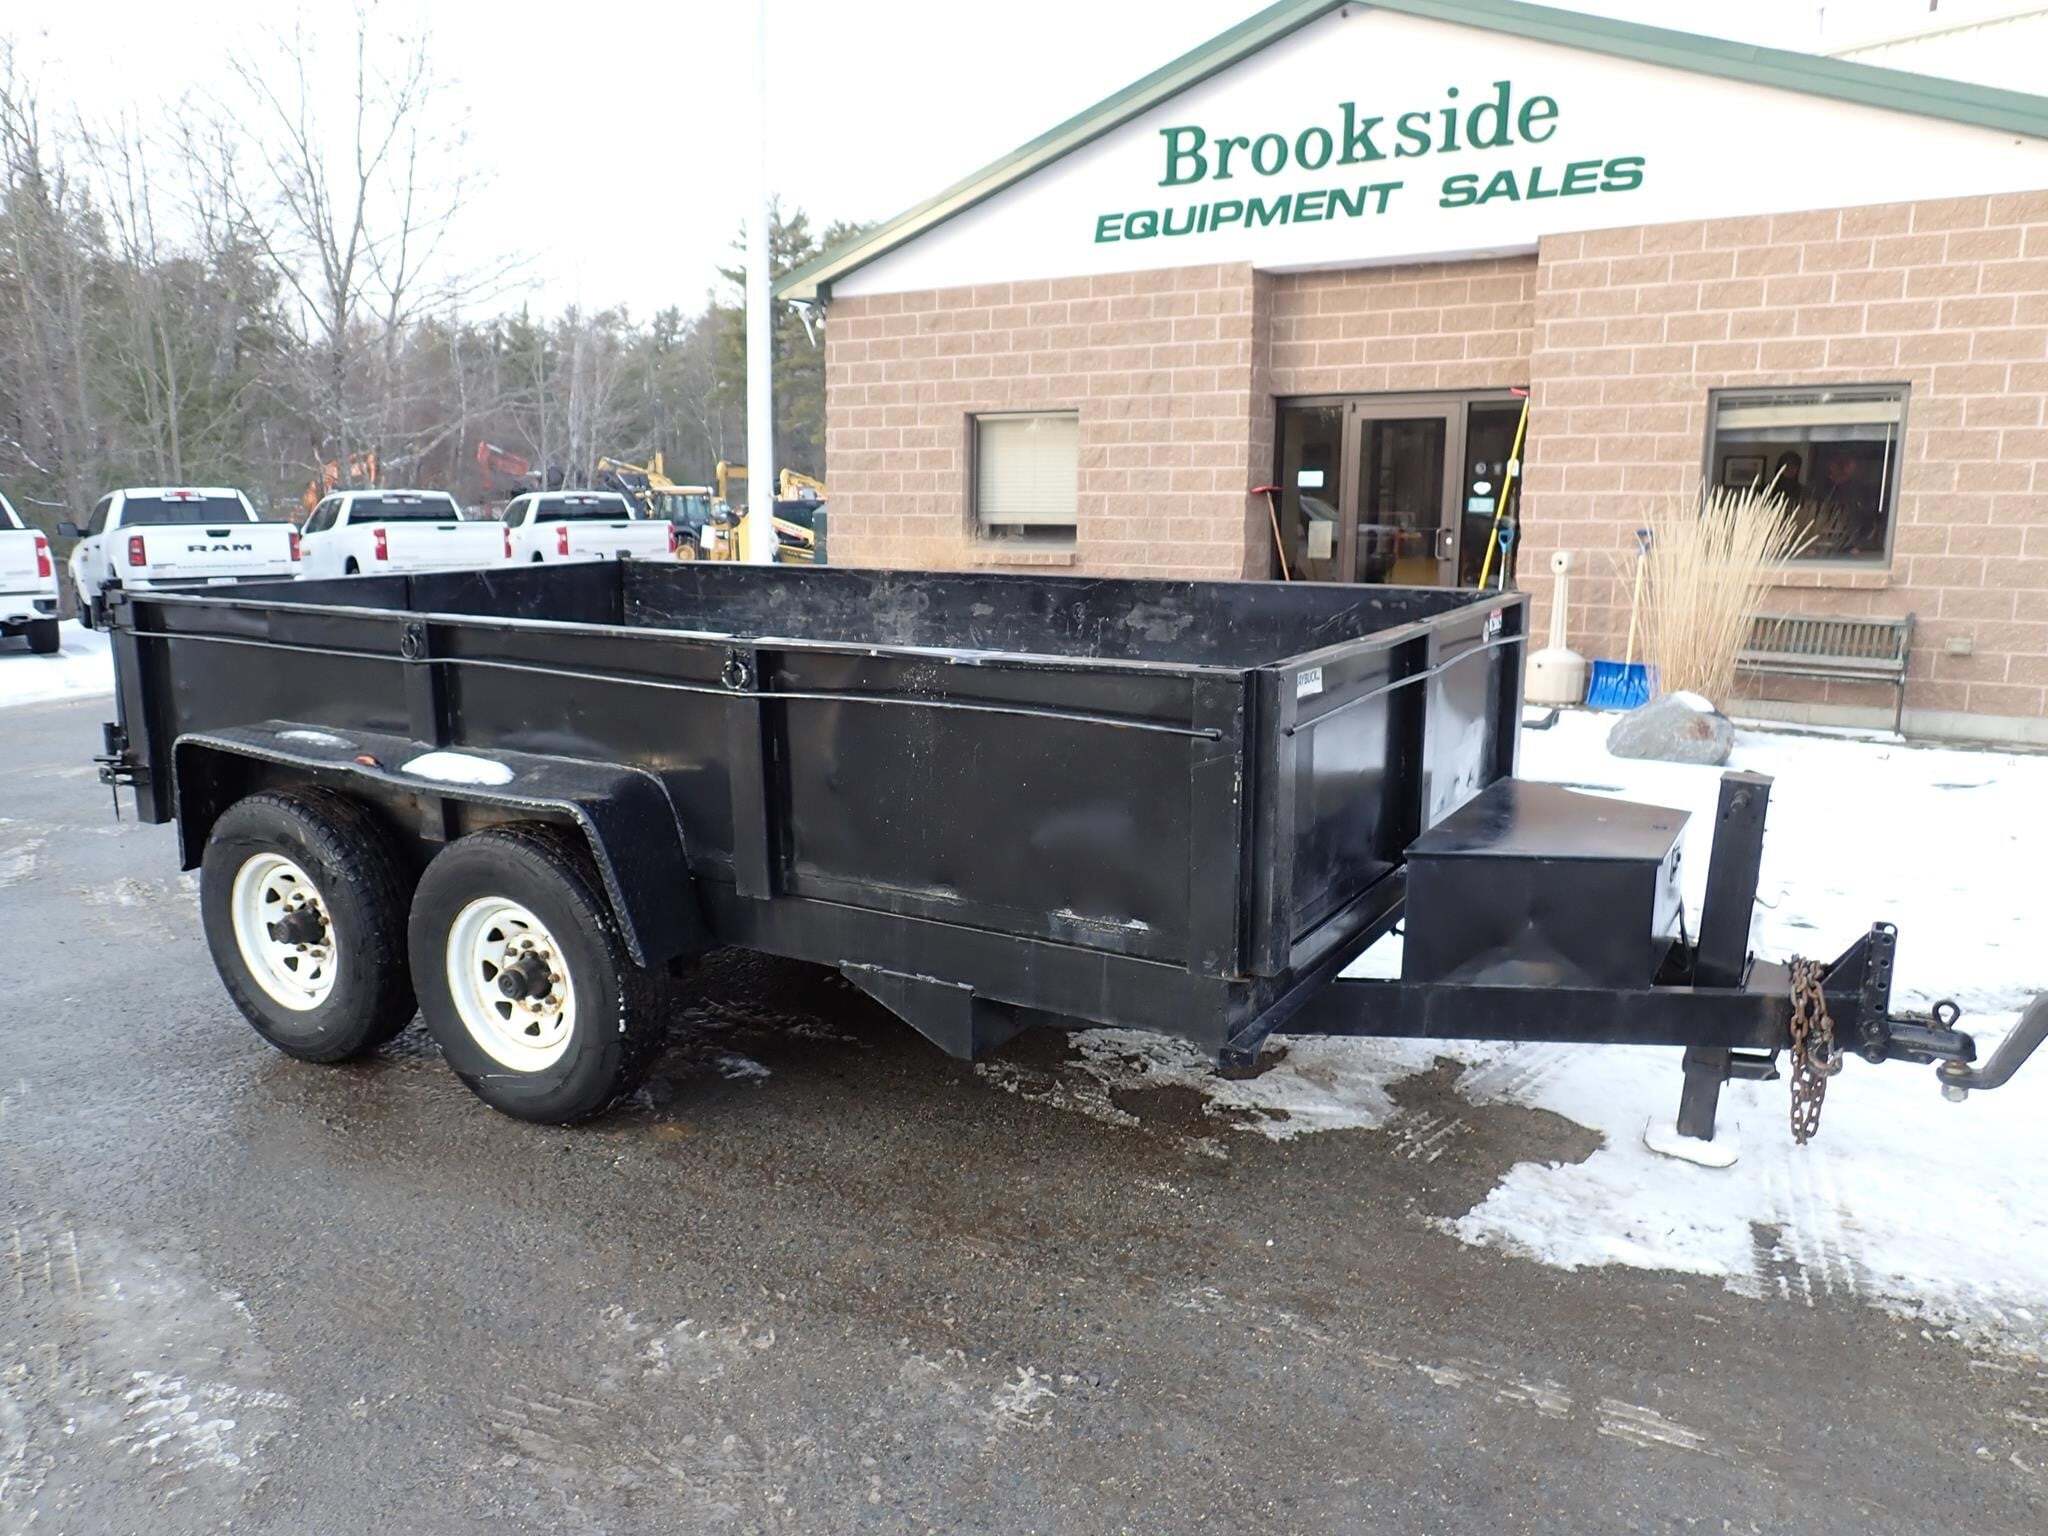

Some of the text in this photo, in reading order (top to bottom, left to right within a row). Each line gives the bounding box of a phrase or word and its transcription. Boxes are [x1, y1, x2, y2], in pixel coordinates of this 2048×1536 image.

[1159, 80, 1559, 187] Brookside
[1094, 155, 1645, 244] EQUIPMENT SALES
[187, 544, 252, 552] RAM
